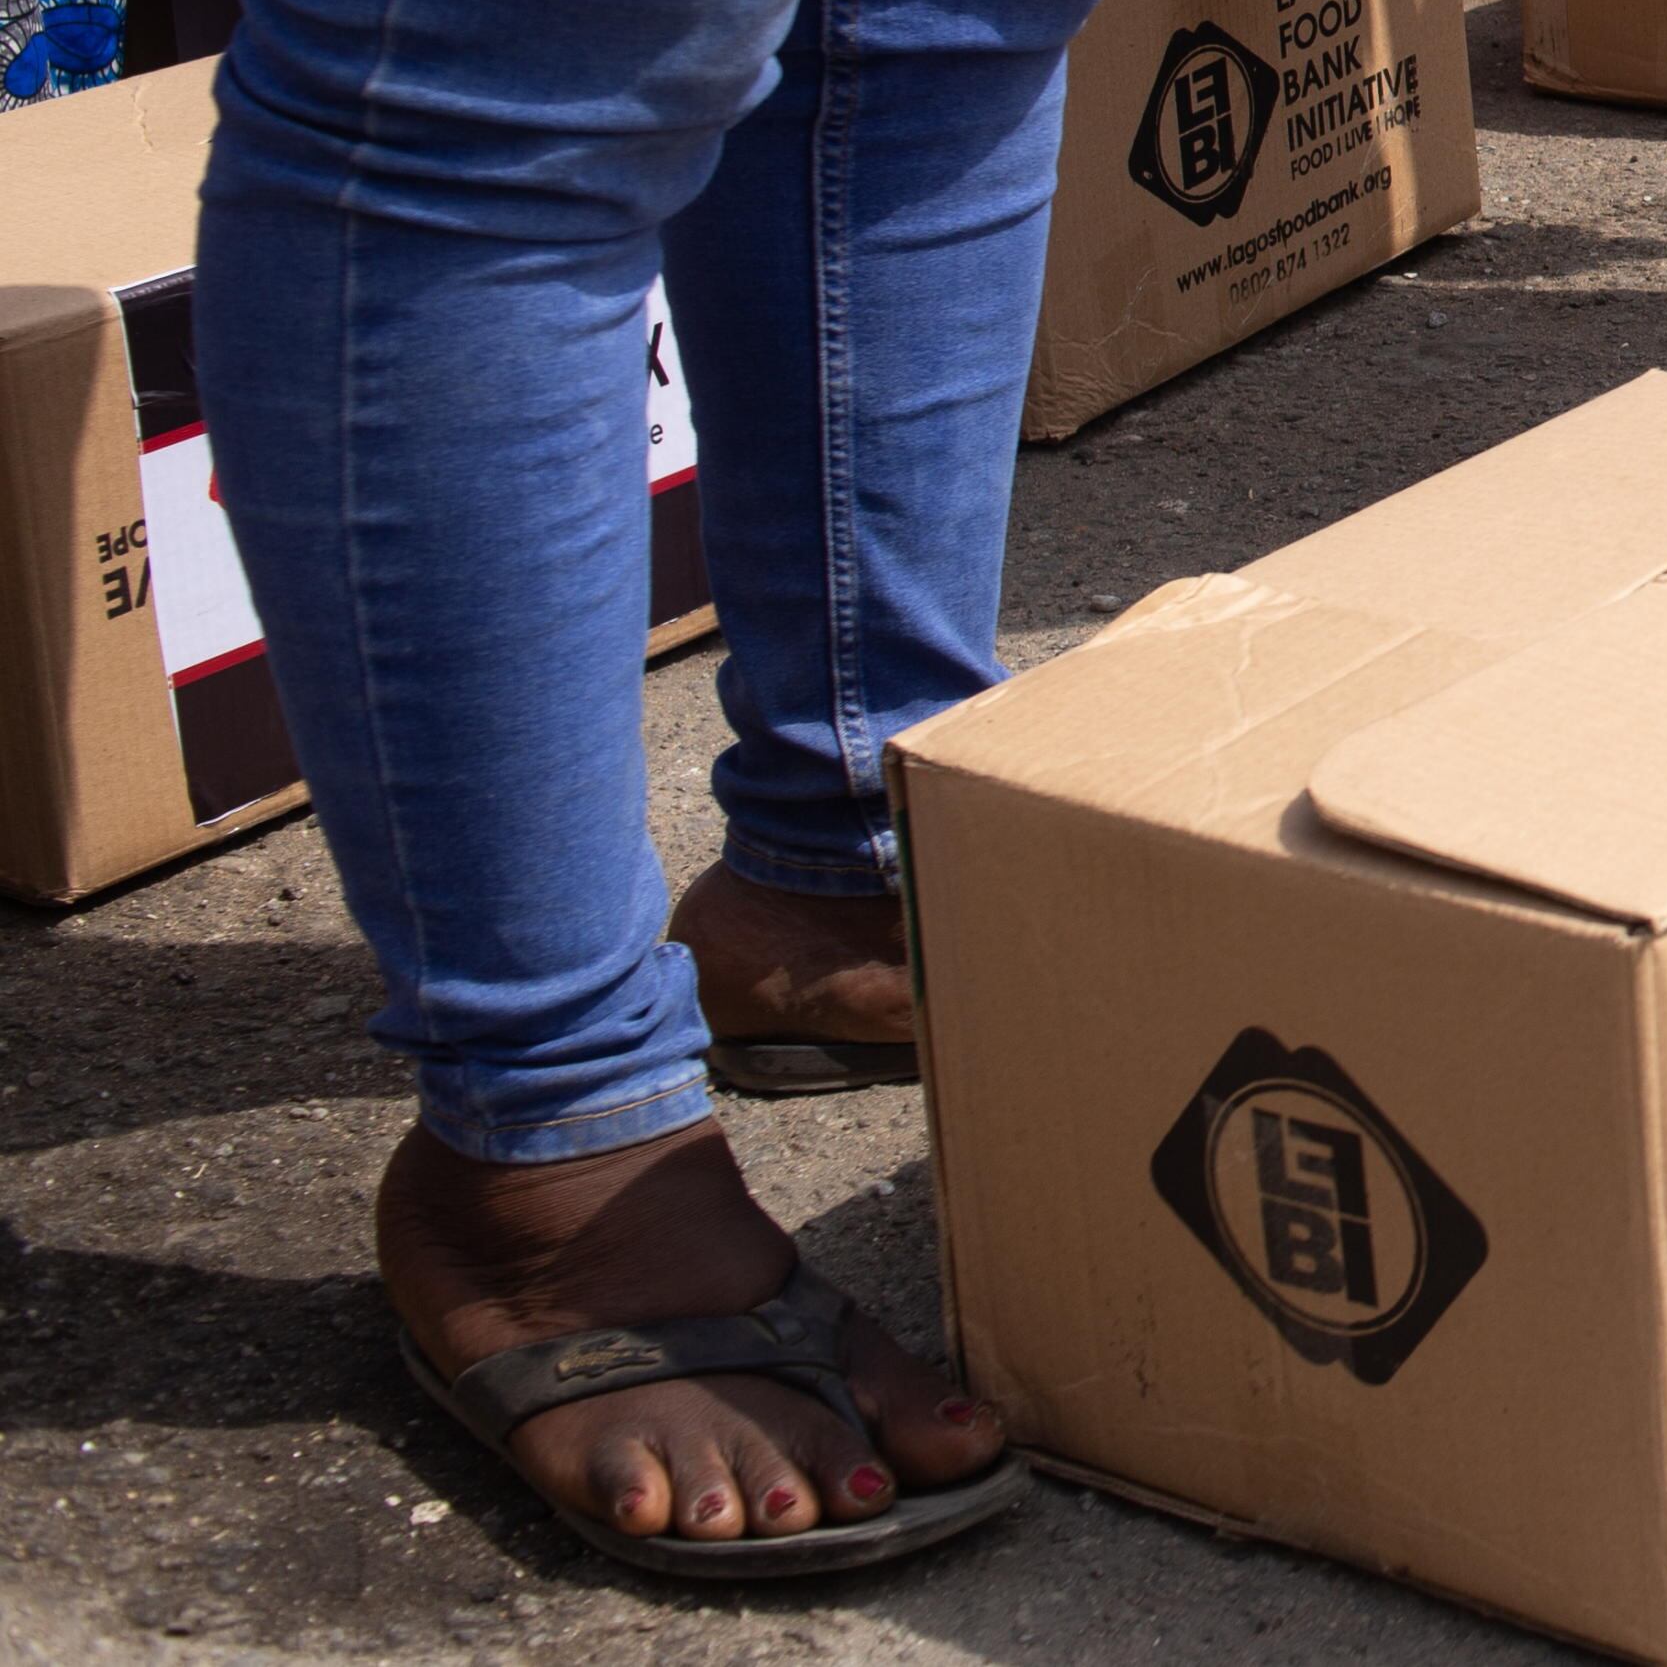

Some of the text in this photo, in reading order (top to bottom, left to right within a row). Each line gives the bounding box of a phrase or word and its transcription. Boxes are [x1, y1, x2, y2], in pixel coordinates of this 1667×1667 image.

[1282, 35, 1362, 107] BANK
[1287, 53, 1419, 153] INITIATIVE
[1290, 142, 1333, 181] FOOD
[1345, 119, 1372, 152] LIVE
[1175, 165, 1392, 294] www.lagosfoodbank.org
[1276, 247, 1307, 282] 874
[1313, 223, 1350, 261] 1322
